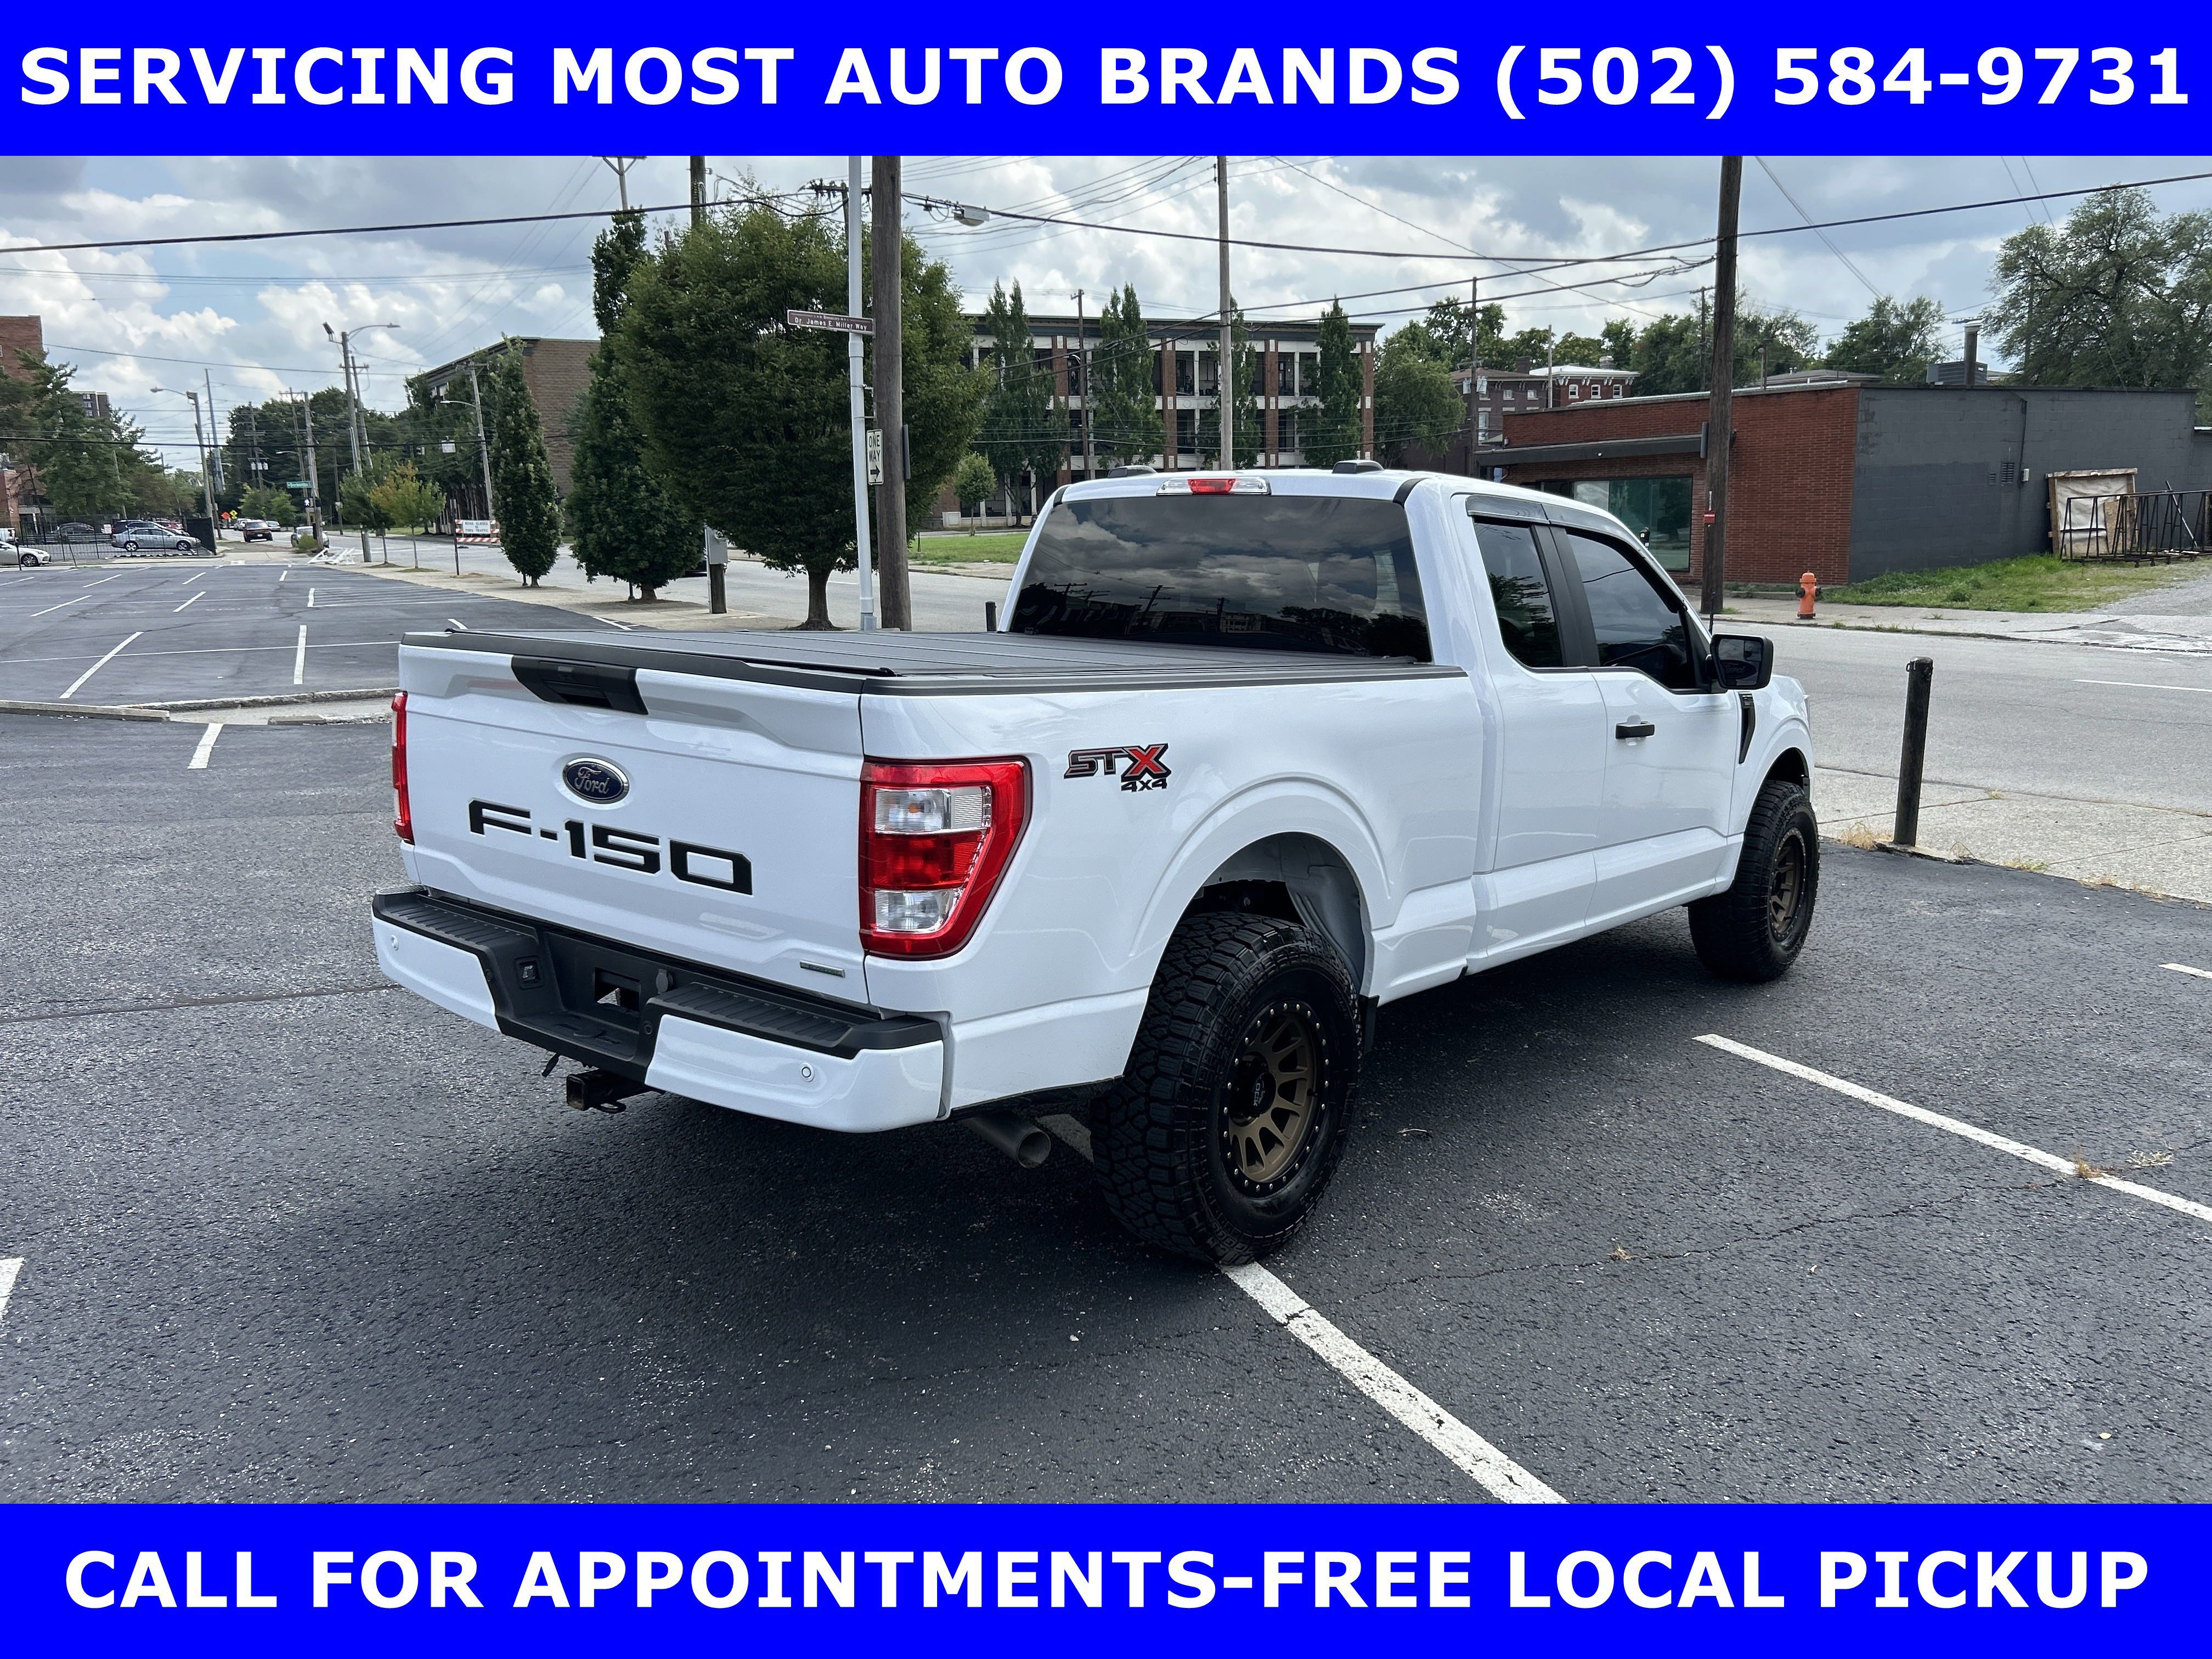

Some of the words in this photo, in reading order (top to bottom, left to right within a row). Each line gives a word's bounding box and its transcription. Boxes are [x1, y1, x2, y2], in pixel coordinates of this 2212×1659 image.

[868, 435, 880, 448] ONE
[869, 450, 881, 462] WAY
[1064, 743, 1172, 783] STX
[574, 766, 610, 794] Ford
[468, 799, 754, 896] F-150
